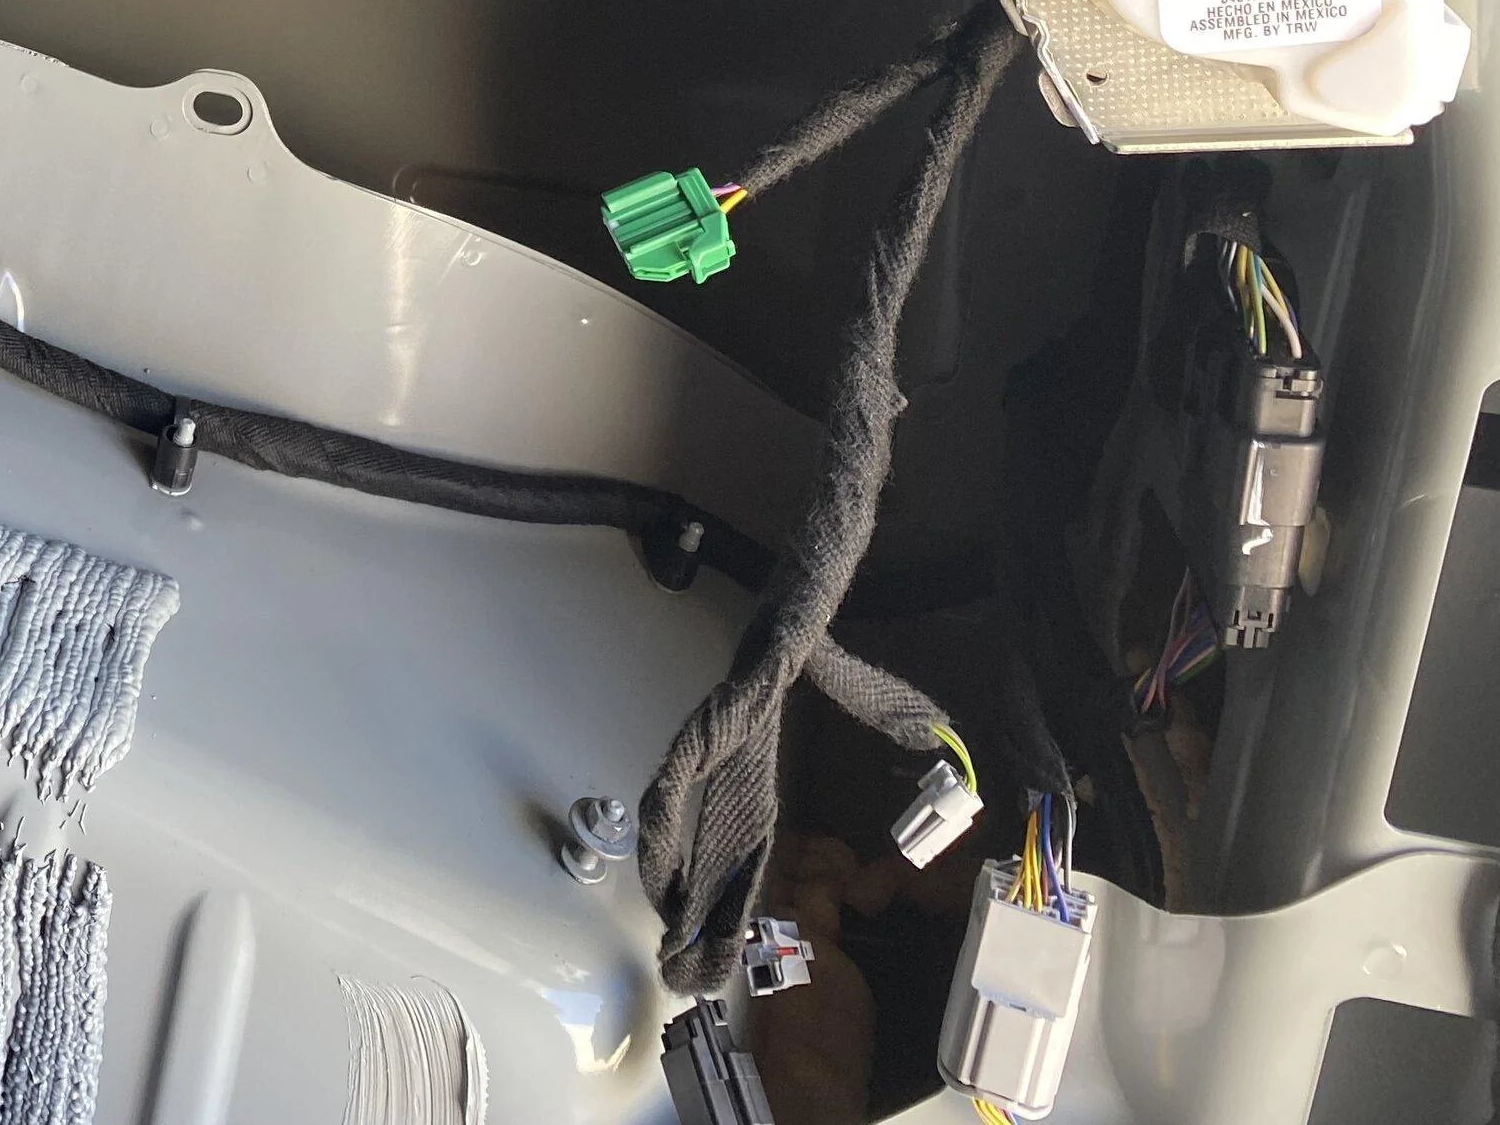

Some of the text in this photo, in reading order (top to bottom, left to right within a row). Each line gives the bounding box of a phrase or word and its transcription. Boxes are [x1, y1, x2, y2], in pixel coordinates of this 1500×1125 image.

[1190, 5, 1348, 32] ASSEMBLED IN MEXICO
[1207, 3, 1252, 19] HECHO
[1258, 1, 1275, 14] EN
[1223, 21, 1318, 41] MFG. BY TRW
